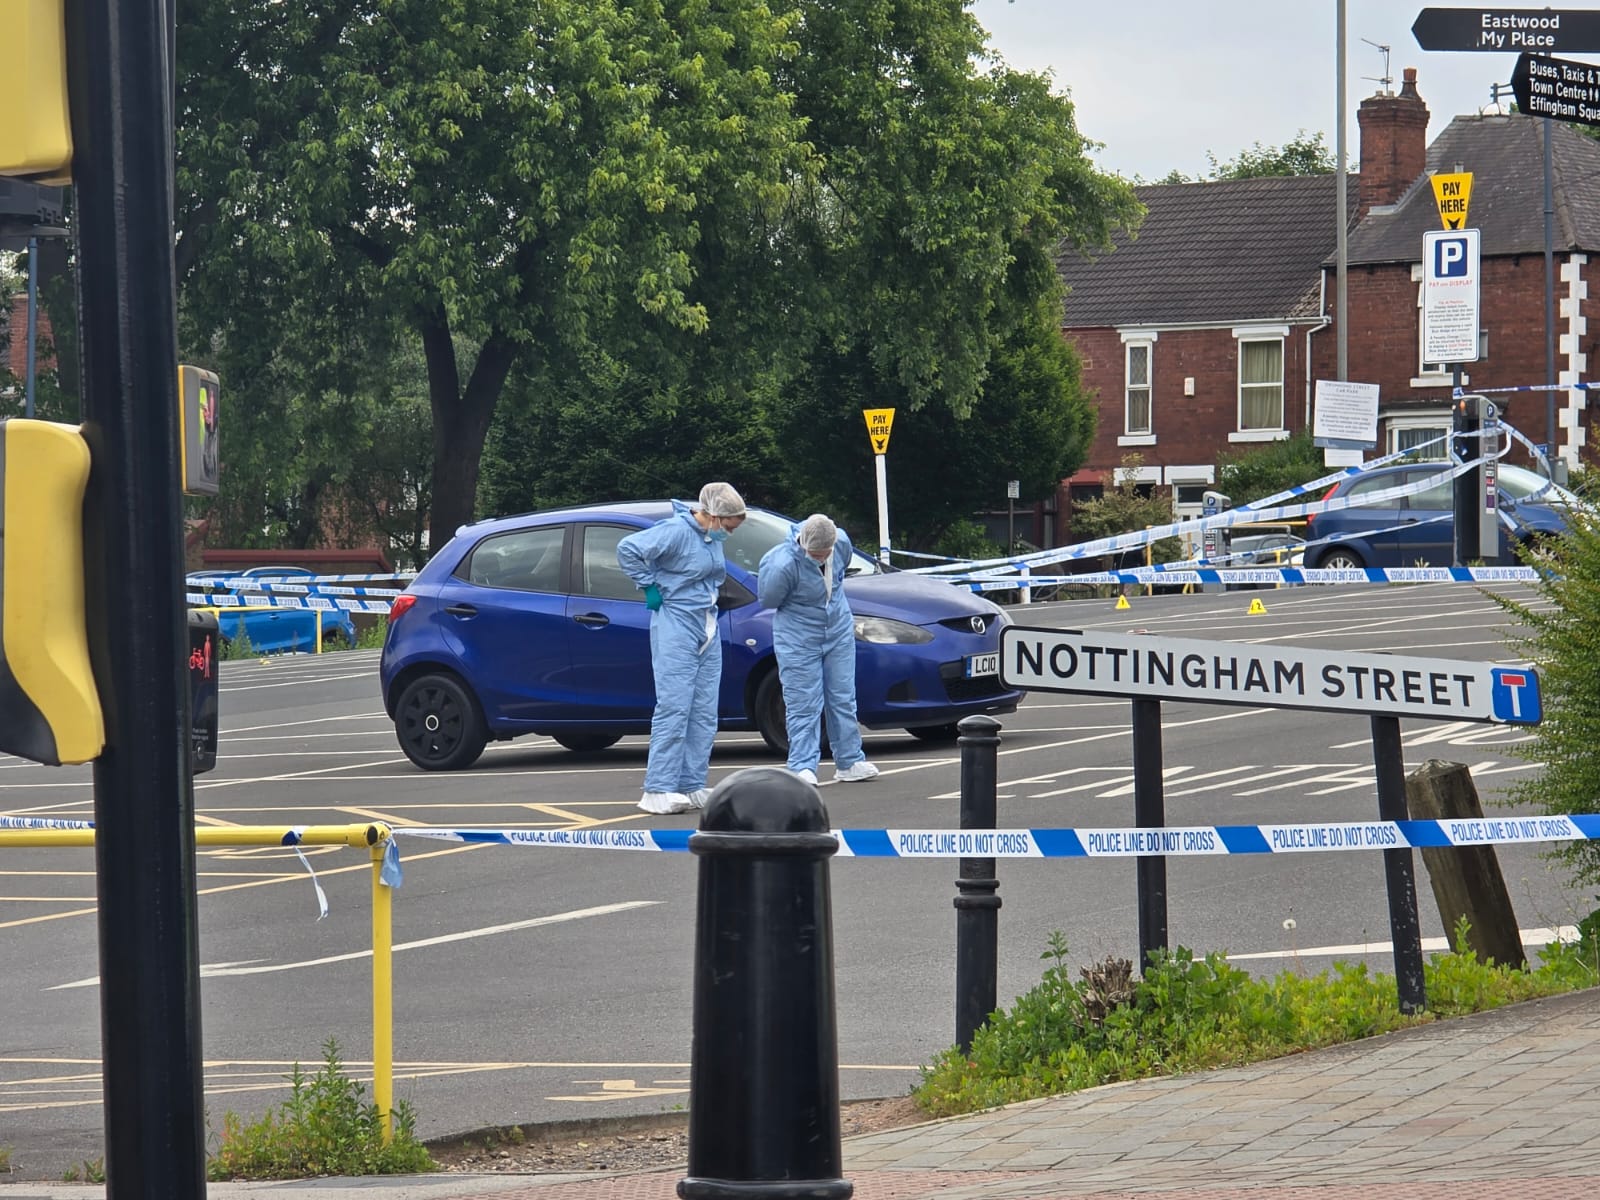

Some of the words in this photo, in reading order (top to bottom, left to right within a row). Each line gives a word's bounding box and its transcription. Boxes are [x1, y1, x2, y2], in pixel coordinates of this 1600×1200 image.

[1482, 13, 1559, 28] Eastwood
[1482, 31, 1505, 48] My
[1511, 31, 1555, 46] Place
[1530, 60, 1559, 80] Buses,
[1561, 65, 1585, 83] Taxis
[1587, 70, 1594, 84] &
[1529, 78, 1553, 95] Town
[1555, 82, 1587, 100] Centre
[1530, 95, 1576, 116] Effingham
[1442, 182, 1460, 196] PAY
[1441, 199, 1465, 213] HERE
[1441, 241, 1463, 275] P
[873, 415, 886, 424] PAY
[871, 426, 889, 436] HERE
[1016, 640, 1305, 695] NOTTINGHAM
[1321, 664, 1475, 707] STREET
[511, 832, 546, 843] POLICE
[548, 832, 570, 844] LINE
[573, 832, 586, 844] DO
[590, 831, 608, 845] NOT
[611, 831, 645, 847] CROSS
[1273, 829, 1305, 848] POLICE
[1307, 828, 1327, 847] LINE
[1329, 828, 1342, 846] DO
[1344, 827, 1362, 846] NOT
[1365, 825, 1396, 845] CROSS
[1451, 823, 1484, 841] POLICE
[1485, 822, 1505, 840] LINE
[1505, 821, 1519, 838] DO
[1520, 821, 1538, 838] NOT
[1540, 819, 1571, 837] CROSS
[900, 834, 933, 853] POLICE
[936, 834, 957, 853] LINE
[959, 834, 972, 853] DO
[975, 834, 994, 853] NOT
[997, 834, 1028, 853] CROSS
[1089, 833, 1121, 852] POLICE
[1124, 833, 1144, 852] LINE
[1147, 832, 1160, 851] DO
[1163, 832, 1181, 851] NOT
[1184, 831, 1214, 850] CROSS
